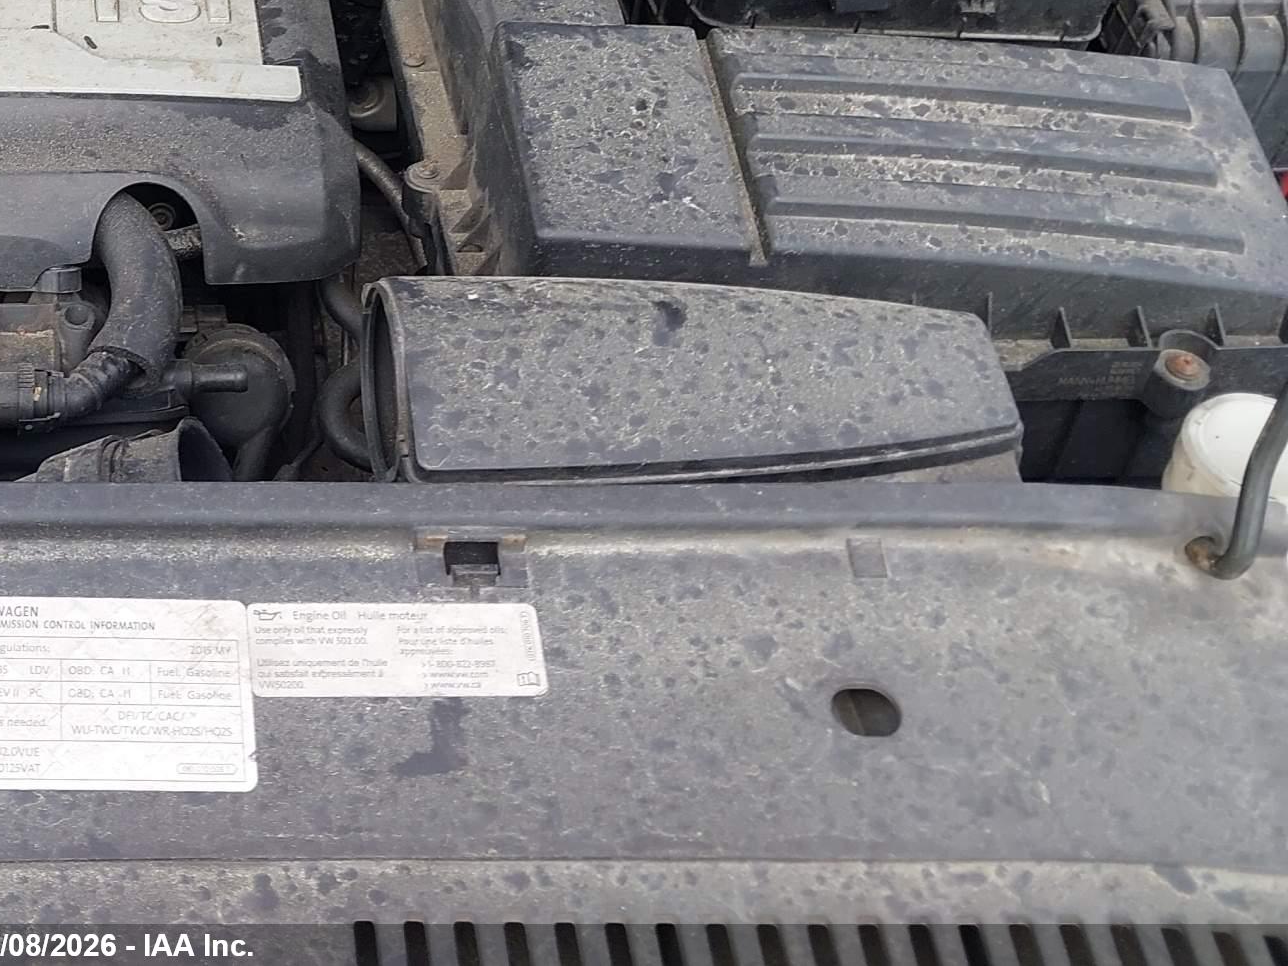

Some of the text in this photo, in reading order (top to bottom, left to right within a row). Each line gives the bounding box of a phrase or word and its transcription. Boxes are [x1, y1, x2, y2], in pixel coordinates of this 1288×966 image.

[293, 611, 329, 623] Engine
[332, 611, 346, 620] Oil
[358, 611, 385, 620] Huile
[43, 620, 85, 630] CONTROL
[90, 621, 155, 631] INFORMATION
[29, 666, 50, 675] LDV
[100, 666, 114, 675] CA
[186, 668, 231, 678] Gasoline
[28, 688, 43, 698] PC
[100, 688, 114, 698] CA
[187, 690, 232, 701] Gasoline
